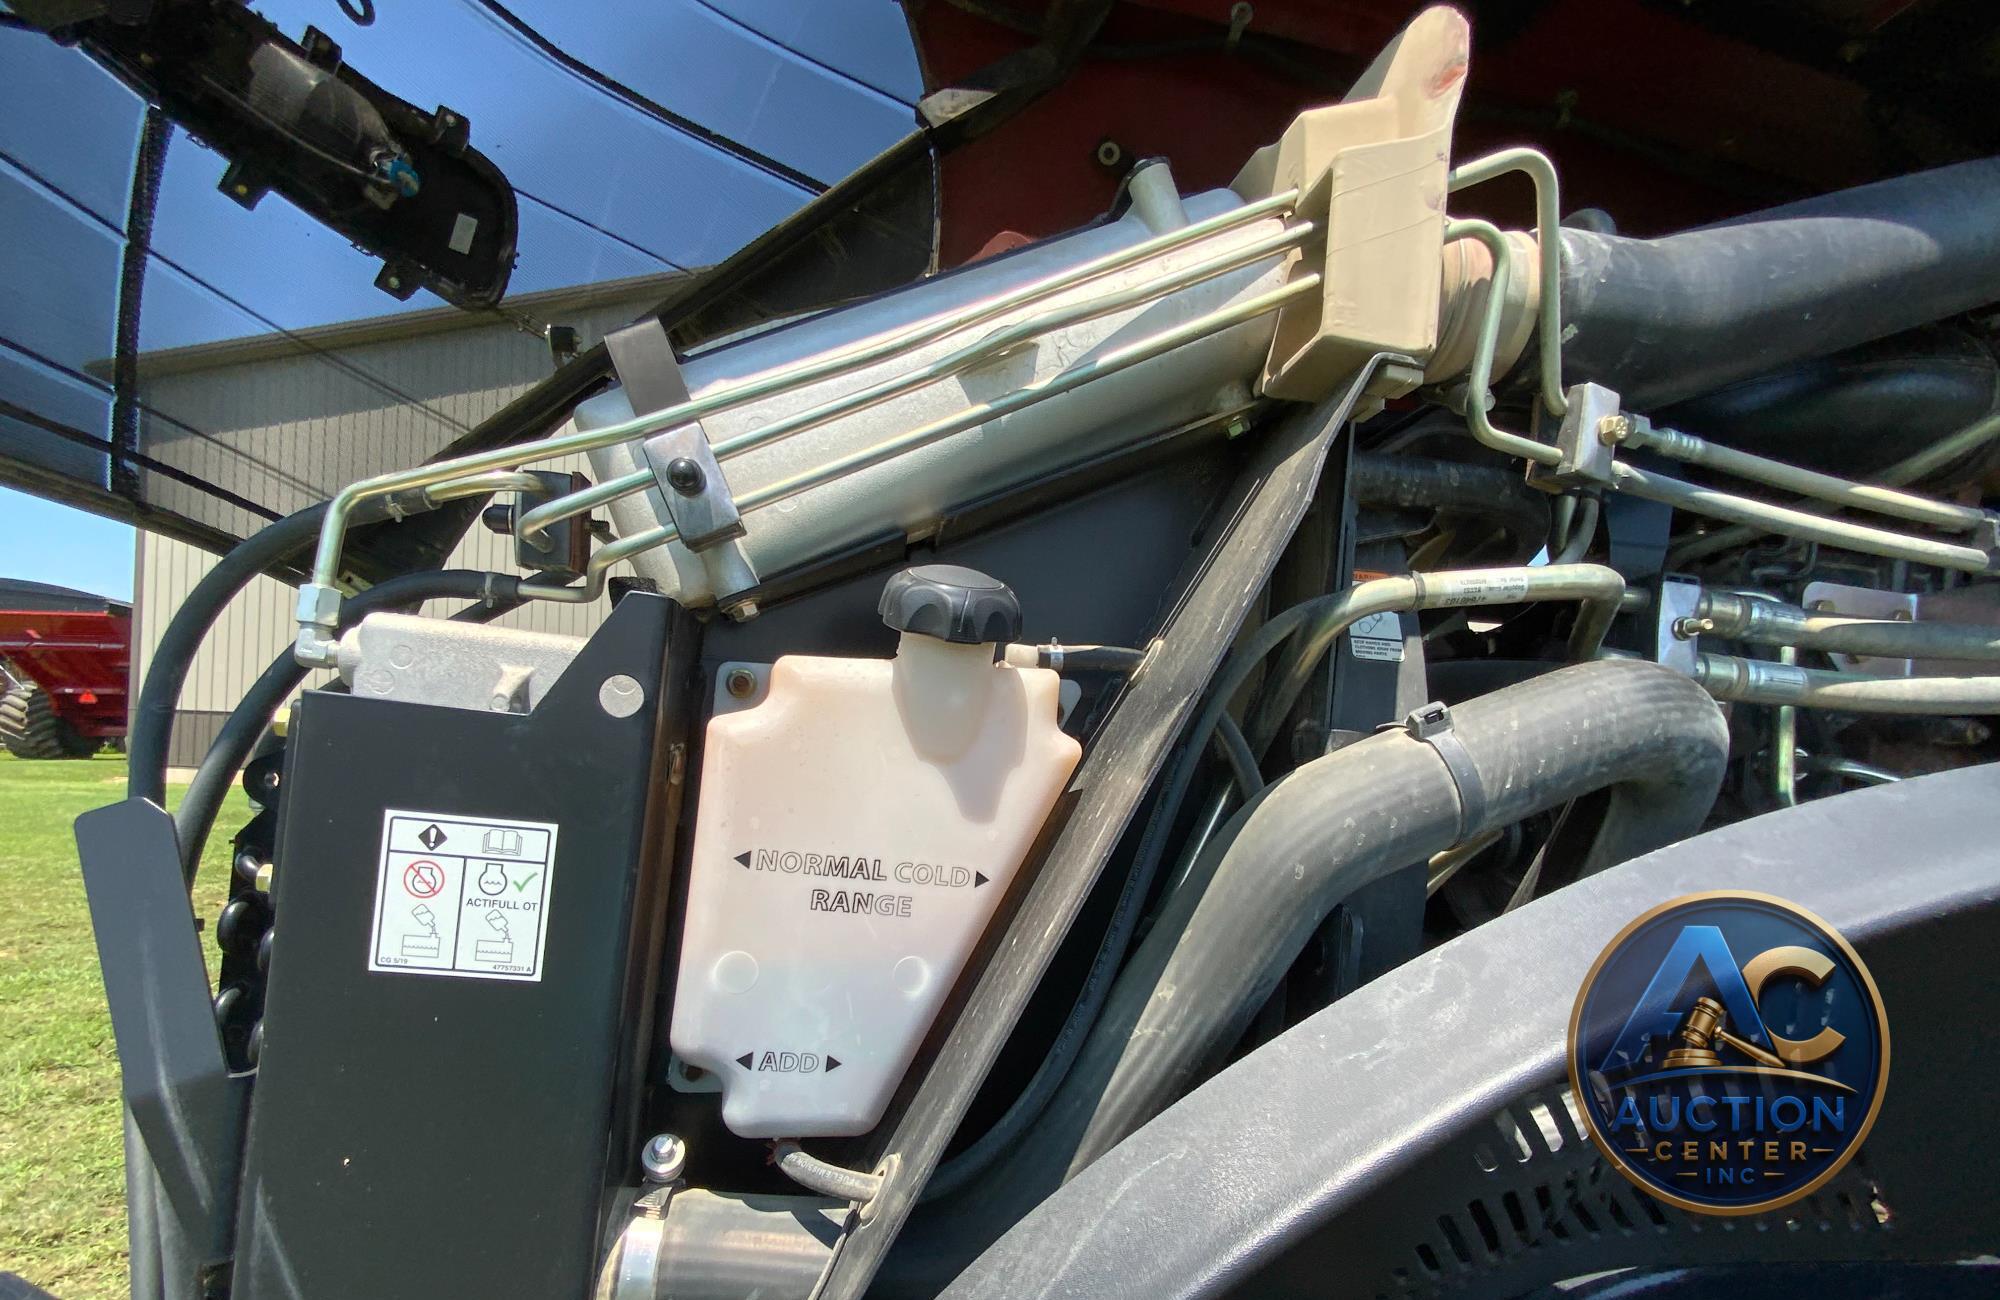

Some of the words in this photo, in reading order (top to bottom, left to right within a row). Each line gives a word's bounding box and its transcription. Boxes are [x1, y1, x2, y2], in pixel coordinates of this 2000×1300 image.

[756, 849, 887, 881] NORMAL
[894, 862, 970, 887] COLD
[466, 898, 519, 910] ACTIFULL
[522, 902, 538, 912] OT
[810, 889, 913, 917] RANGE
[393, 957, 408, 965] 5/19
[758, 1051, 819, 1073] ADD
